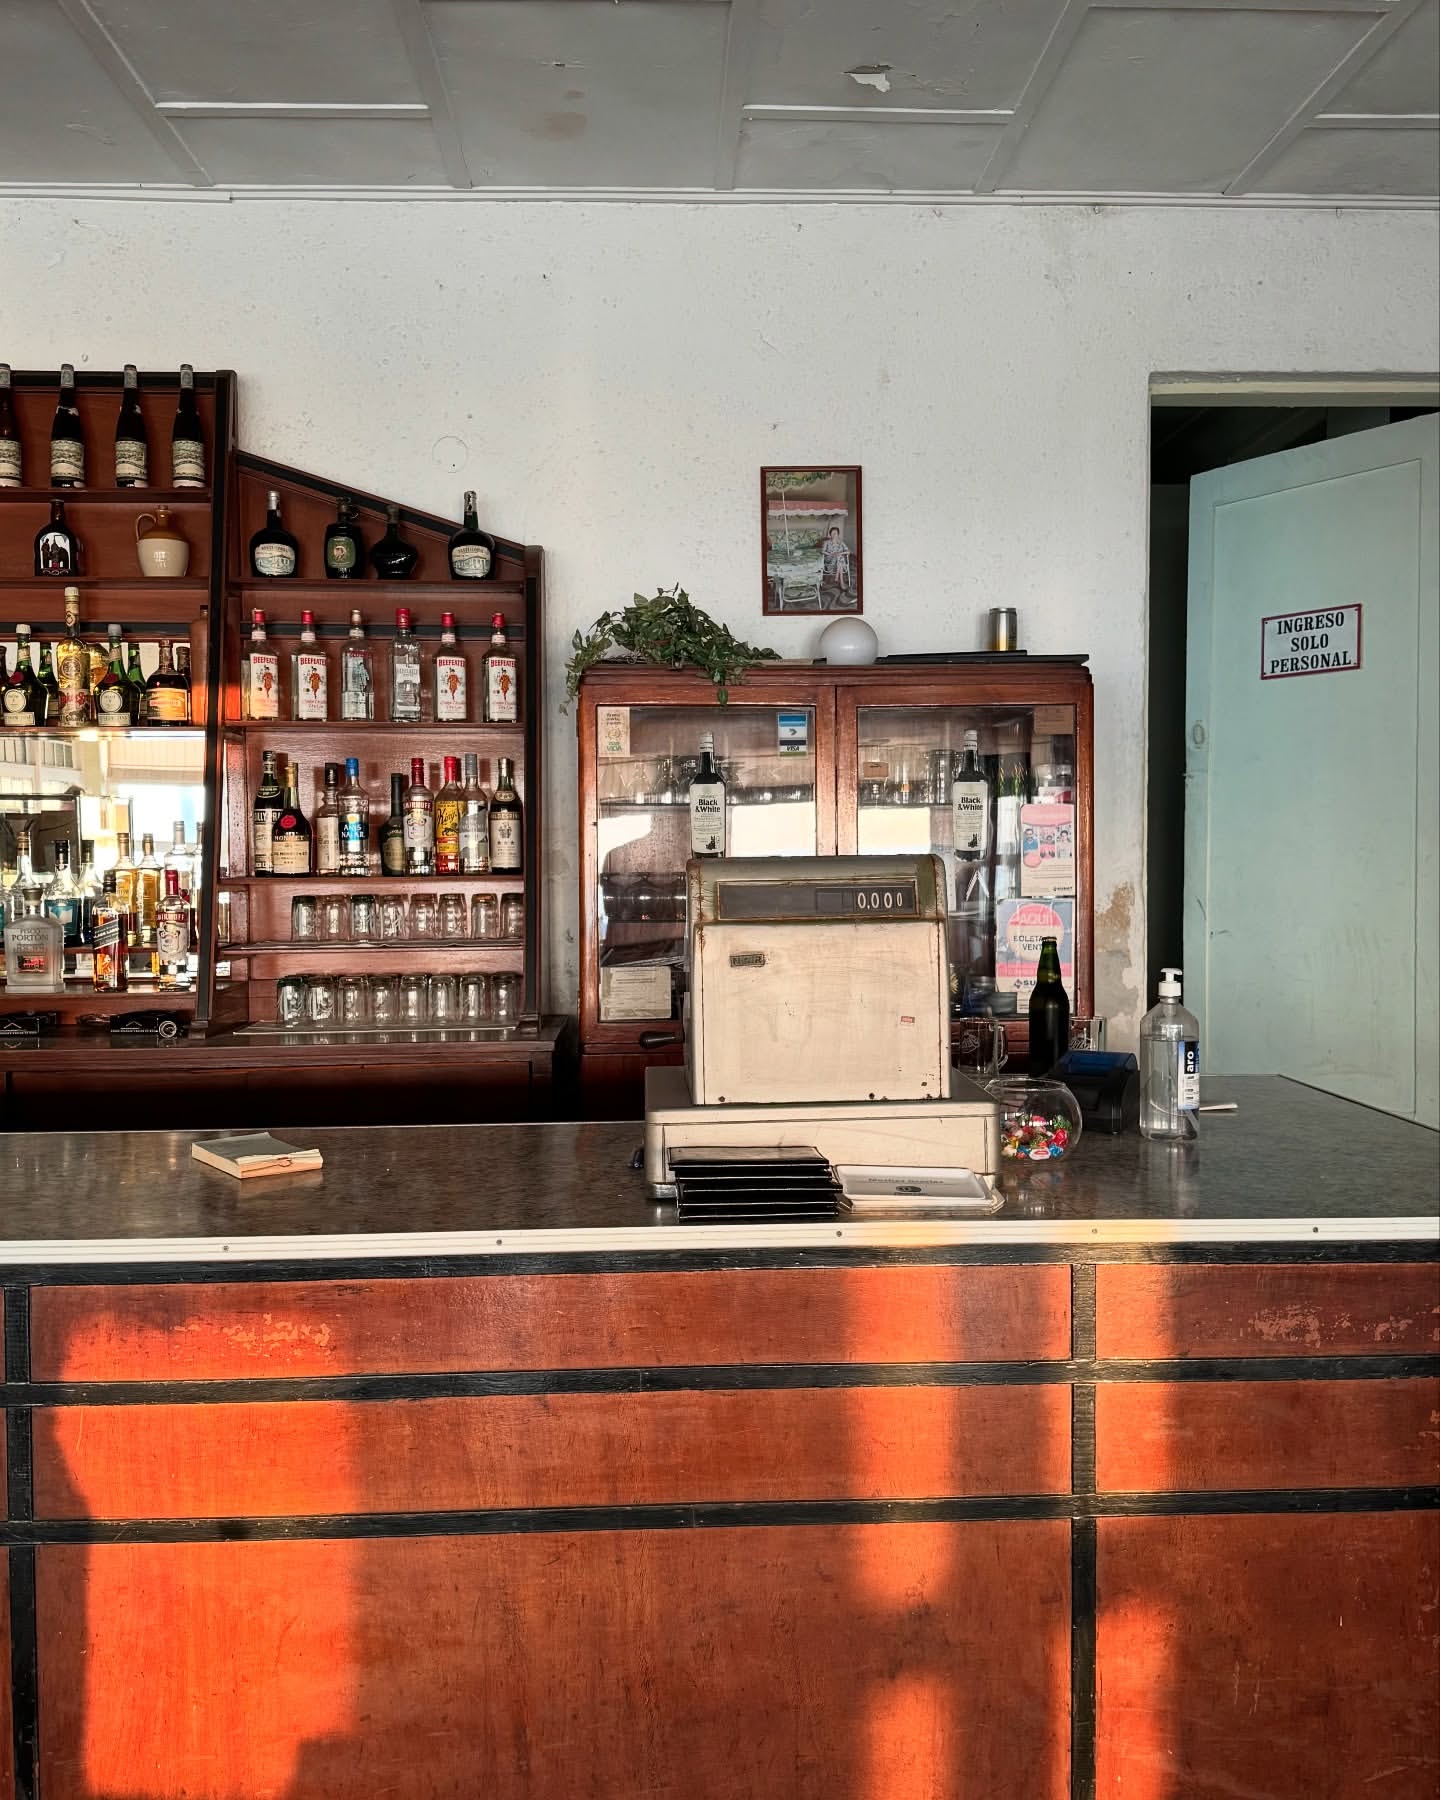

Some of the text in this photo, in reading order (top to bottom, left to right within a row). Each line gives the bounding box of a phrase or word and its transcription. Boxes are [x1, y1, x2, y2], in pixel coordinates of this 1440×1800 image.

[1277, 611, 1344, 635] INGRESO
[1290, 633, 1329, 652] SOLO
[300, 657, 326, 665] BEEFEATE
[438, 659, 465, 667] BEEFEATE
[490, 659, 515, 667] BEEFEATE
[1270, 651, 1352, 674] PERSONAL
[698, 798, 718, 806] Black
[961, 796, 981, 804] Black
[1186, 1050, 1194, 1073] aro
